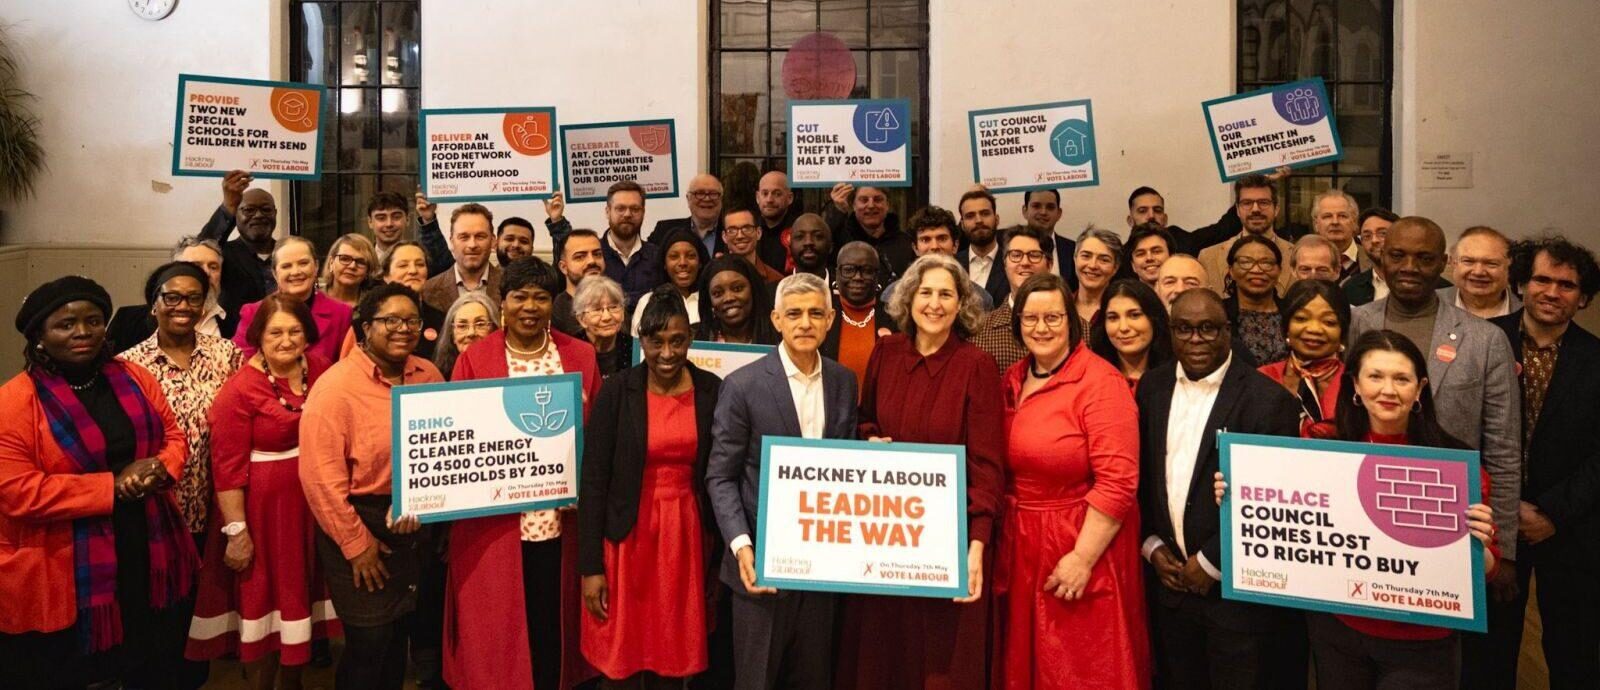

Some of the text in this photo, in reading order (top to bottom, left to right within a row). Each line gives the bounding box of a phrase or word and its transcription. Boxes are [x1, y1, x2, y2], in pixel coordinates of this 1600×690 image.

[190, 94, 240, 105] PROVIDE
[190, 105, 246, 116] TWO NEW
[188, 116, 236, 126] SPECIAL
[979, 115, 1047, 128] CUT COUNCIL
[1218, 118, 1257, 133] DOUBLE
[188, 126, 269, 138] SCHOOLS FOR
[797, 124, 819, 133] CUT
[980, 125, 1046, 138] TAX FOR LOW
[797, 135, 838, 143] MOBILE
[981, 137, 1020, 147] INCOME
[1221, 132, 1242, 141] OUR
[1223, 129, 1298, 150] INVESTMENT IN
[187, 137, 307, 150] CHILDREN WITH SEND
[432, 142, 494, 151] AFFORDABLE
[570, 141, 620, 150] CELEBRATE
[797, 145, 845, 154] THEFT IN
[1226, 136, 1316, 160] APPRENTICESHIPS
[462, 151, 512, 159] NETWORK
[593, 149, 631, 158] CULTURE
[982, 145, 1034, 157] RESIDENTS
[1308, 148, 1331, 157] LABOUR
[592, 156, 653, 166] COMMUNITIES
[797, 157, 826, 165] HALF
[845, 156, 872, 165] 2030
[432, 170, 519, 179] NEIGHBOURHOOD
[594, 174, 637, 183] BOROUGH
[408, 417, 454, 430] BRING
[408, 430, 474, 445] CHEAPER
[408, 438, 532, 460] CLEANER ENERGY
[409, 452, 539, 474] TO 4500 COUNCIL
[409, 463, 564, 489] HOUSEHOLDS BY 2030
[778, 466, 947, 487] HACKNEY LABOUR
[408, 493, 446, 504] Hackney
[508, 487, 568, 499] VOTE LABOUR
[1240, 486, 1330, 508] REPLACE
[799, 491, 925, 519] LEADING
[1240, 505, 1334, 527] COUNCIL
[798, 519, 924, 547] THE WAY
[1241, 523, 1370, 550] HOMES LOST
[1242, 542, 1419, 576] TO RIGHT TO BUY
[892, 562, 920, 571] Thursday
[908, 573, 949, 582] LABOUR
[1241, 568, 1288, 581] Hackney
[1251, 578, 1287, 590] Labour
[1386, 584, 1424, 596] Thursday
[1426, 588, 1440, 597] 7th
[1442, 591, 1459, 600] May
[1372, 592, 1405, 605] VOTE
[1408, 596, 1461, 612] LABOUR
